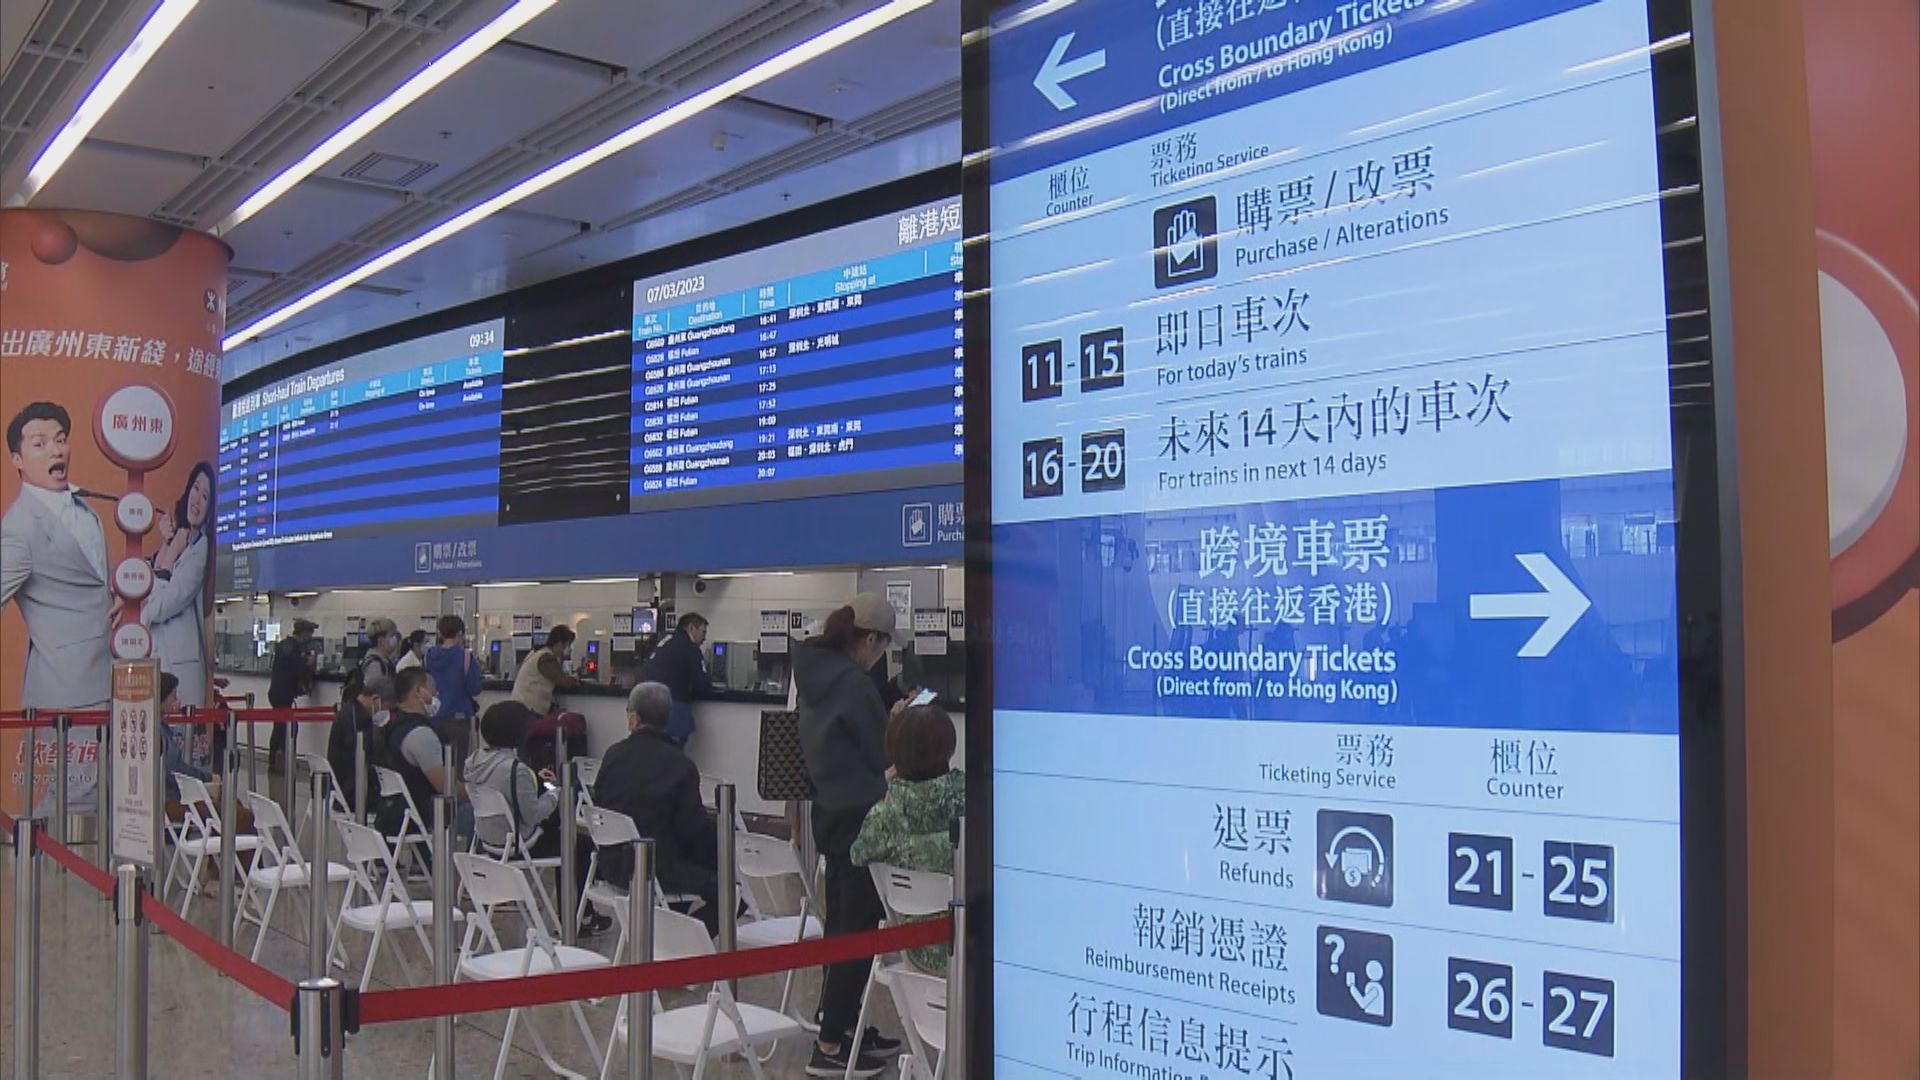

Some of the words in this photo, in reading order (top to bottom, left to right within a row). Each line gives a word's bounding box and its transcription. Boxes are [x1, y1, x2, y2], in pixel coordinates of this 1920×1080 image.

[1158, 56, 1215, 88] Cross
[1220, 14, 1333, 69] Boundary
[1160, 85, 1212, 114] (Direct
[1213, 71, 1252, 95] from
[1267, 62, 1284, 79] to
[1288, 46, 1334, 72] Hong
[1338, 23, 1393, 57] Kong)
[1151, 132, 1197, 169] 票務
[1151, 161, 1213, 188] Ticketing
[1217, 145, 1269, 170] Service
[1049, 166, 1089, 200] 櫃位
[1236, 146, 1435, 237] 購票/改票
[898, 203, 961, 246] 離港短
[1046, 194, 1094, 217] Counter
[1236, 235, 1318, 267] Purchase
[1336, 207, 1449, 246] Alterations
[647, 276, 705, 303] 07/03/2023
[470, 330, 494, 347] 09:34
[1156, 288, 1310, 355] 即日車次
[291, 379, 306, 395] Train
[307, 368, 344, 391] Departures
[1027, 352, 1056, 390] 11
[1084, 340, 1119, 380] 15
[1157, 366, 1183, 386] For
[1255, 346, 1307, 372] trains
[112, 414, 163, 433] 廣州東
[1159, 373, 1512, 462] 未來14天內的車次
[1027, 448, 1060, 487] 16
[1084, 441, 1122, 481] 20
[1159, 470, 1187, 490] For
[1190, 465, 1238, 488] trains
[1243, 463, 1260, 482] in
[1266, 458, 1307, 480] next
[1313, 455, 1335, 476] 14
[1341, 451, 1387, 477] days
[1199, 514, 1390, 580] 跨境車票
[792, 615, 801, 627] 17
[952, 614, 962, 627] 18
[1168, 580, 1392, 629] (直接往返香港)
[1127, 646, 1184, 671] Cross
[1189, 643, 1303, 678] Boundary
[1306, 643, 1397, 673] Tickets
[1156, 675, 1210, 697] (Direct
[1212, 675, 1252, 697] from
[1266, 680, 1285, 698] to
[1288, 679, 1336, 703] Hong
[1341, 679, 1398, 705] Kong)
[1336, 734, 1394, 767] 票務
[1490, 738, 1558, 776] 櫃位
[1259, 763, 1331, 789] Ticketing
[1336, 768, 1396, 789] Service
[1487, 778, 1564, 799] Counter
[1213, 803, 1292, 855] 退票
[1219, 861, 1294, 889] Refunds
[1454, 846, 1503, 895] 21
[1548, 856, 1608, 907] 25
[1133, 902, 1289, 972] 報銷憑證
[1085, 946, 1214, 989] Reimbursement
[1219, 972, 1296, 1006] Receipts
[1454, 972, 1510, 1023] 26
[1548, 986, 1609, 1039] 27
[1067, 992, 1294, 1080] 行程信息提示
[1066, 1041, 1096, 1069] Trip
[1099, 1049, 1192, 1080] Informatio
